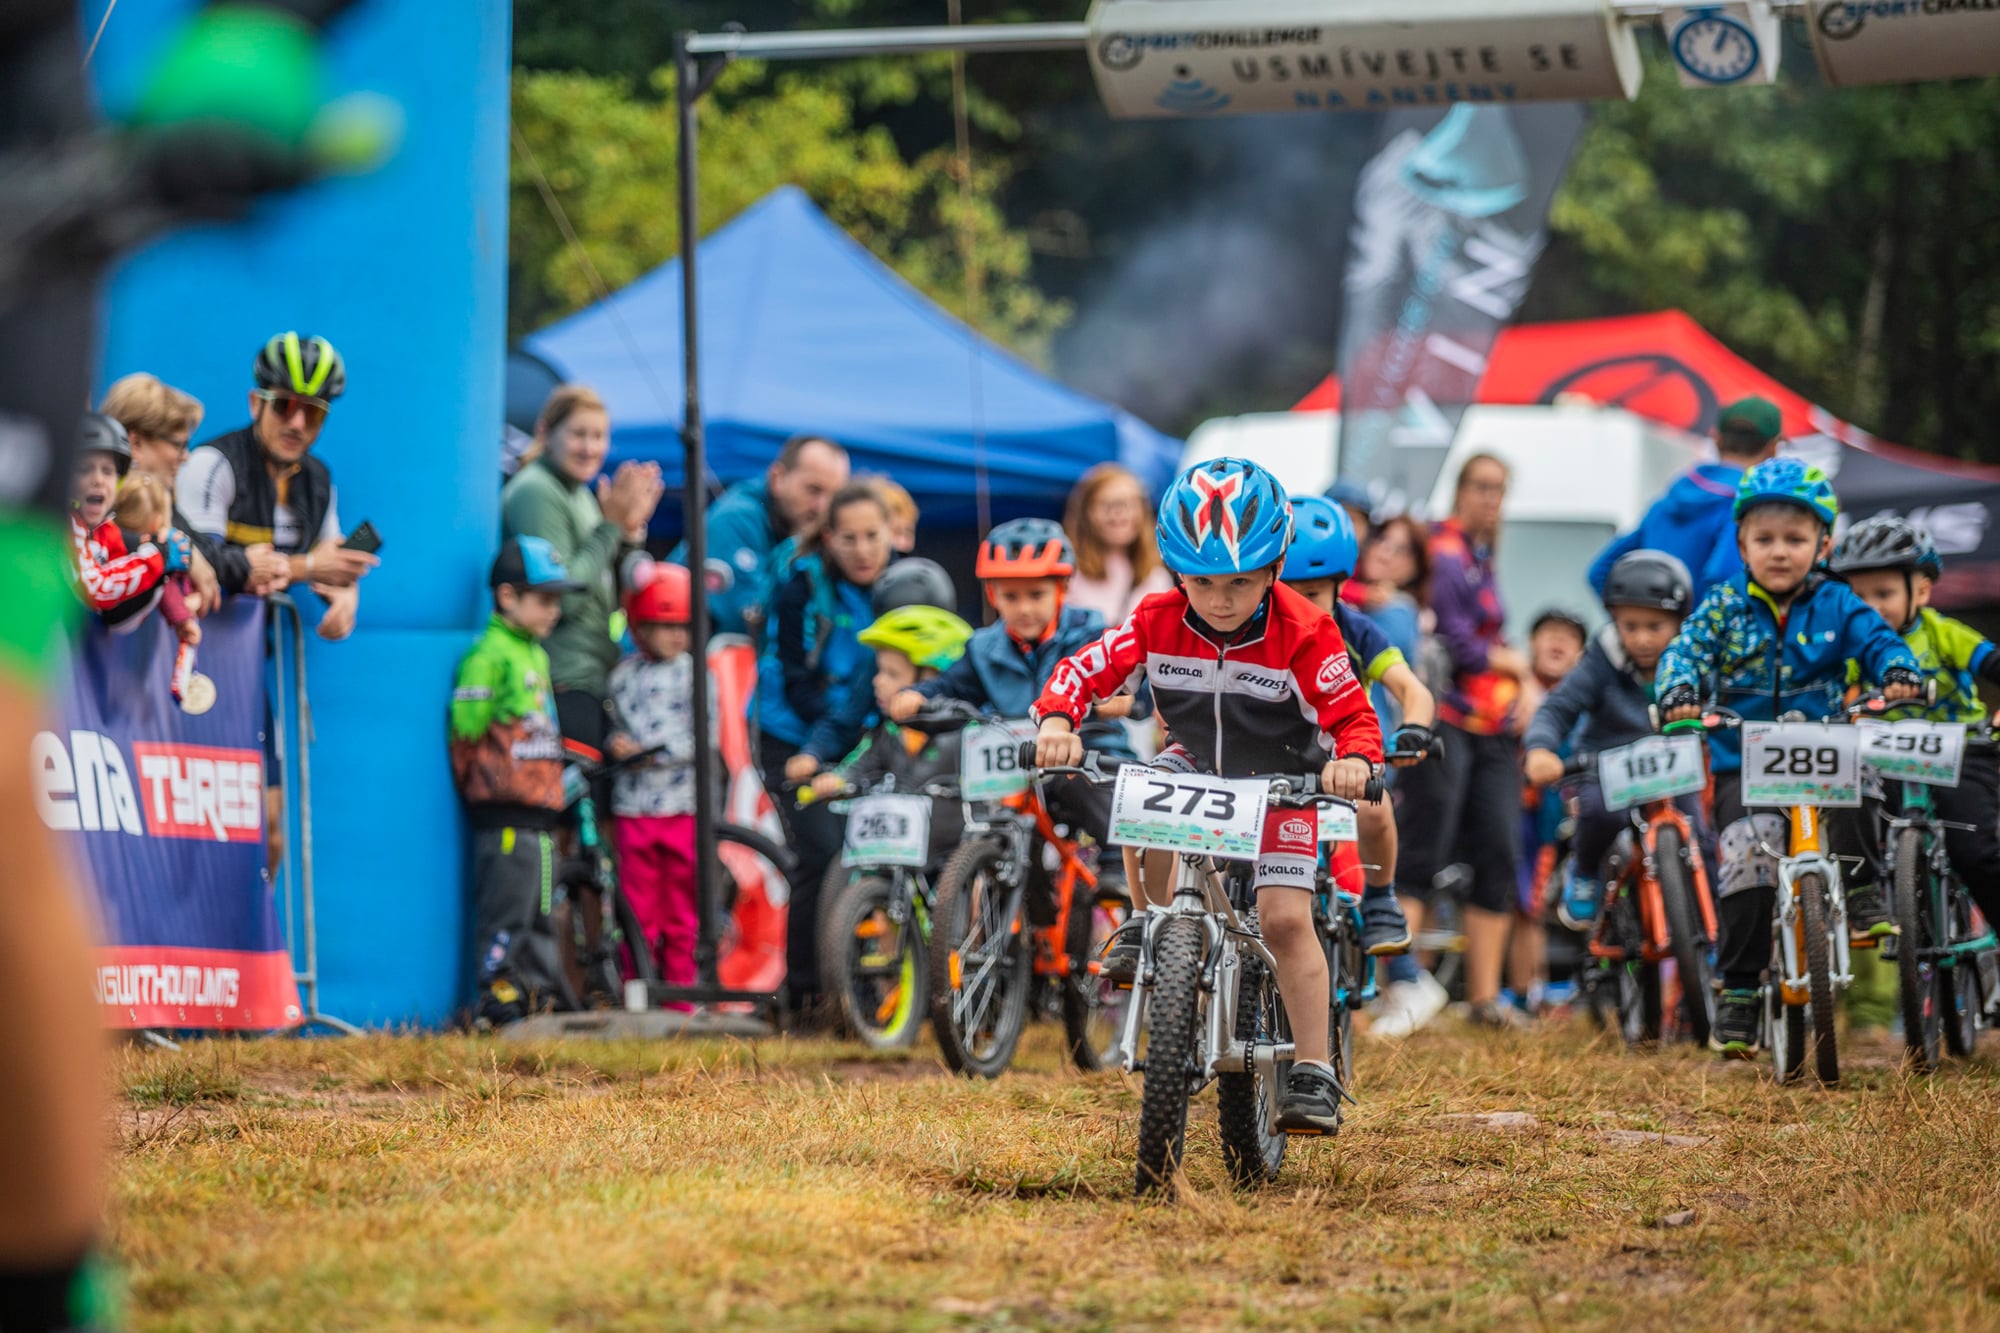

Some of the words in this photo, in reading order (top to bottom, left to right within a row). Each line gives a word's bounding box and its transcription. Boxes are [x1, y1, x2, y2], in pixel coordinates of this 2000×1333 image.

[1528, 44, 1581, 71] SE
[1293, 89, 1346, 107] NA
[1236, 672, 1289, 691] GHOST
[982, 745, 1016, 771] 18
[1624, 752, 1677, 780] 187
[1763, 746, 1839, 775] 289
[140, 754, 260, 842] TYRES
[1143, 781, 1237, 821] 273
[1285, 823, 1309, 835] TOP
